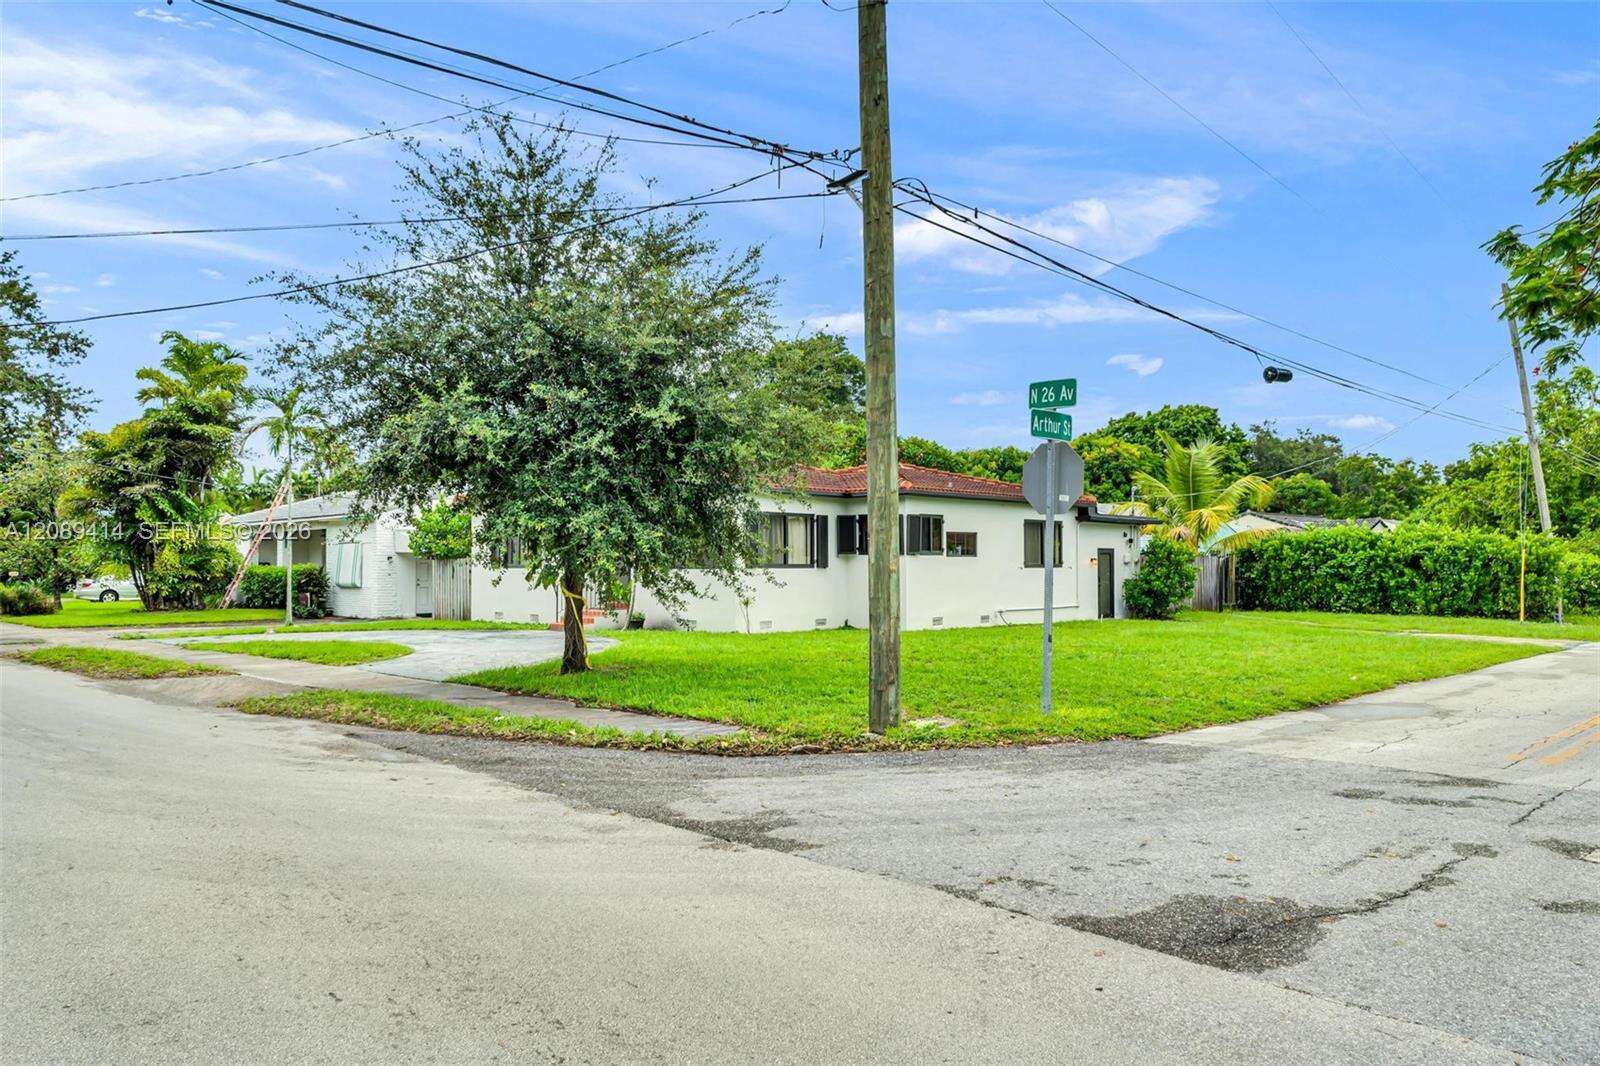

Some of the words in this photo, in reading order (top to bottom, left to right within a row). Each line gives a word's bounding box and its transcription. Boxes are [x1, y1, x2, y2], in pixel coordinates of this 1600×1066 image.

[1031, 389, 1038, 404] N
[1041, 387, 1055, 403] 26
[1060, 385, 1074, 401] Av
[1032, 415, 1061, 434] Arthur
[1063, 420, 1071, 436] St
